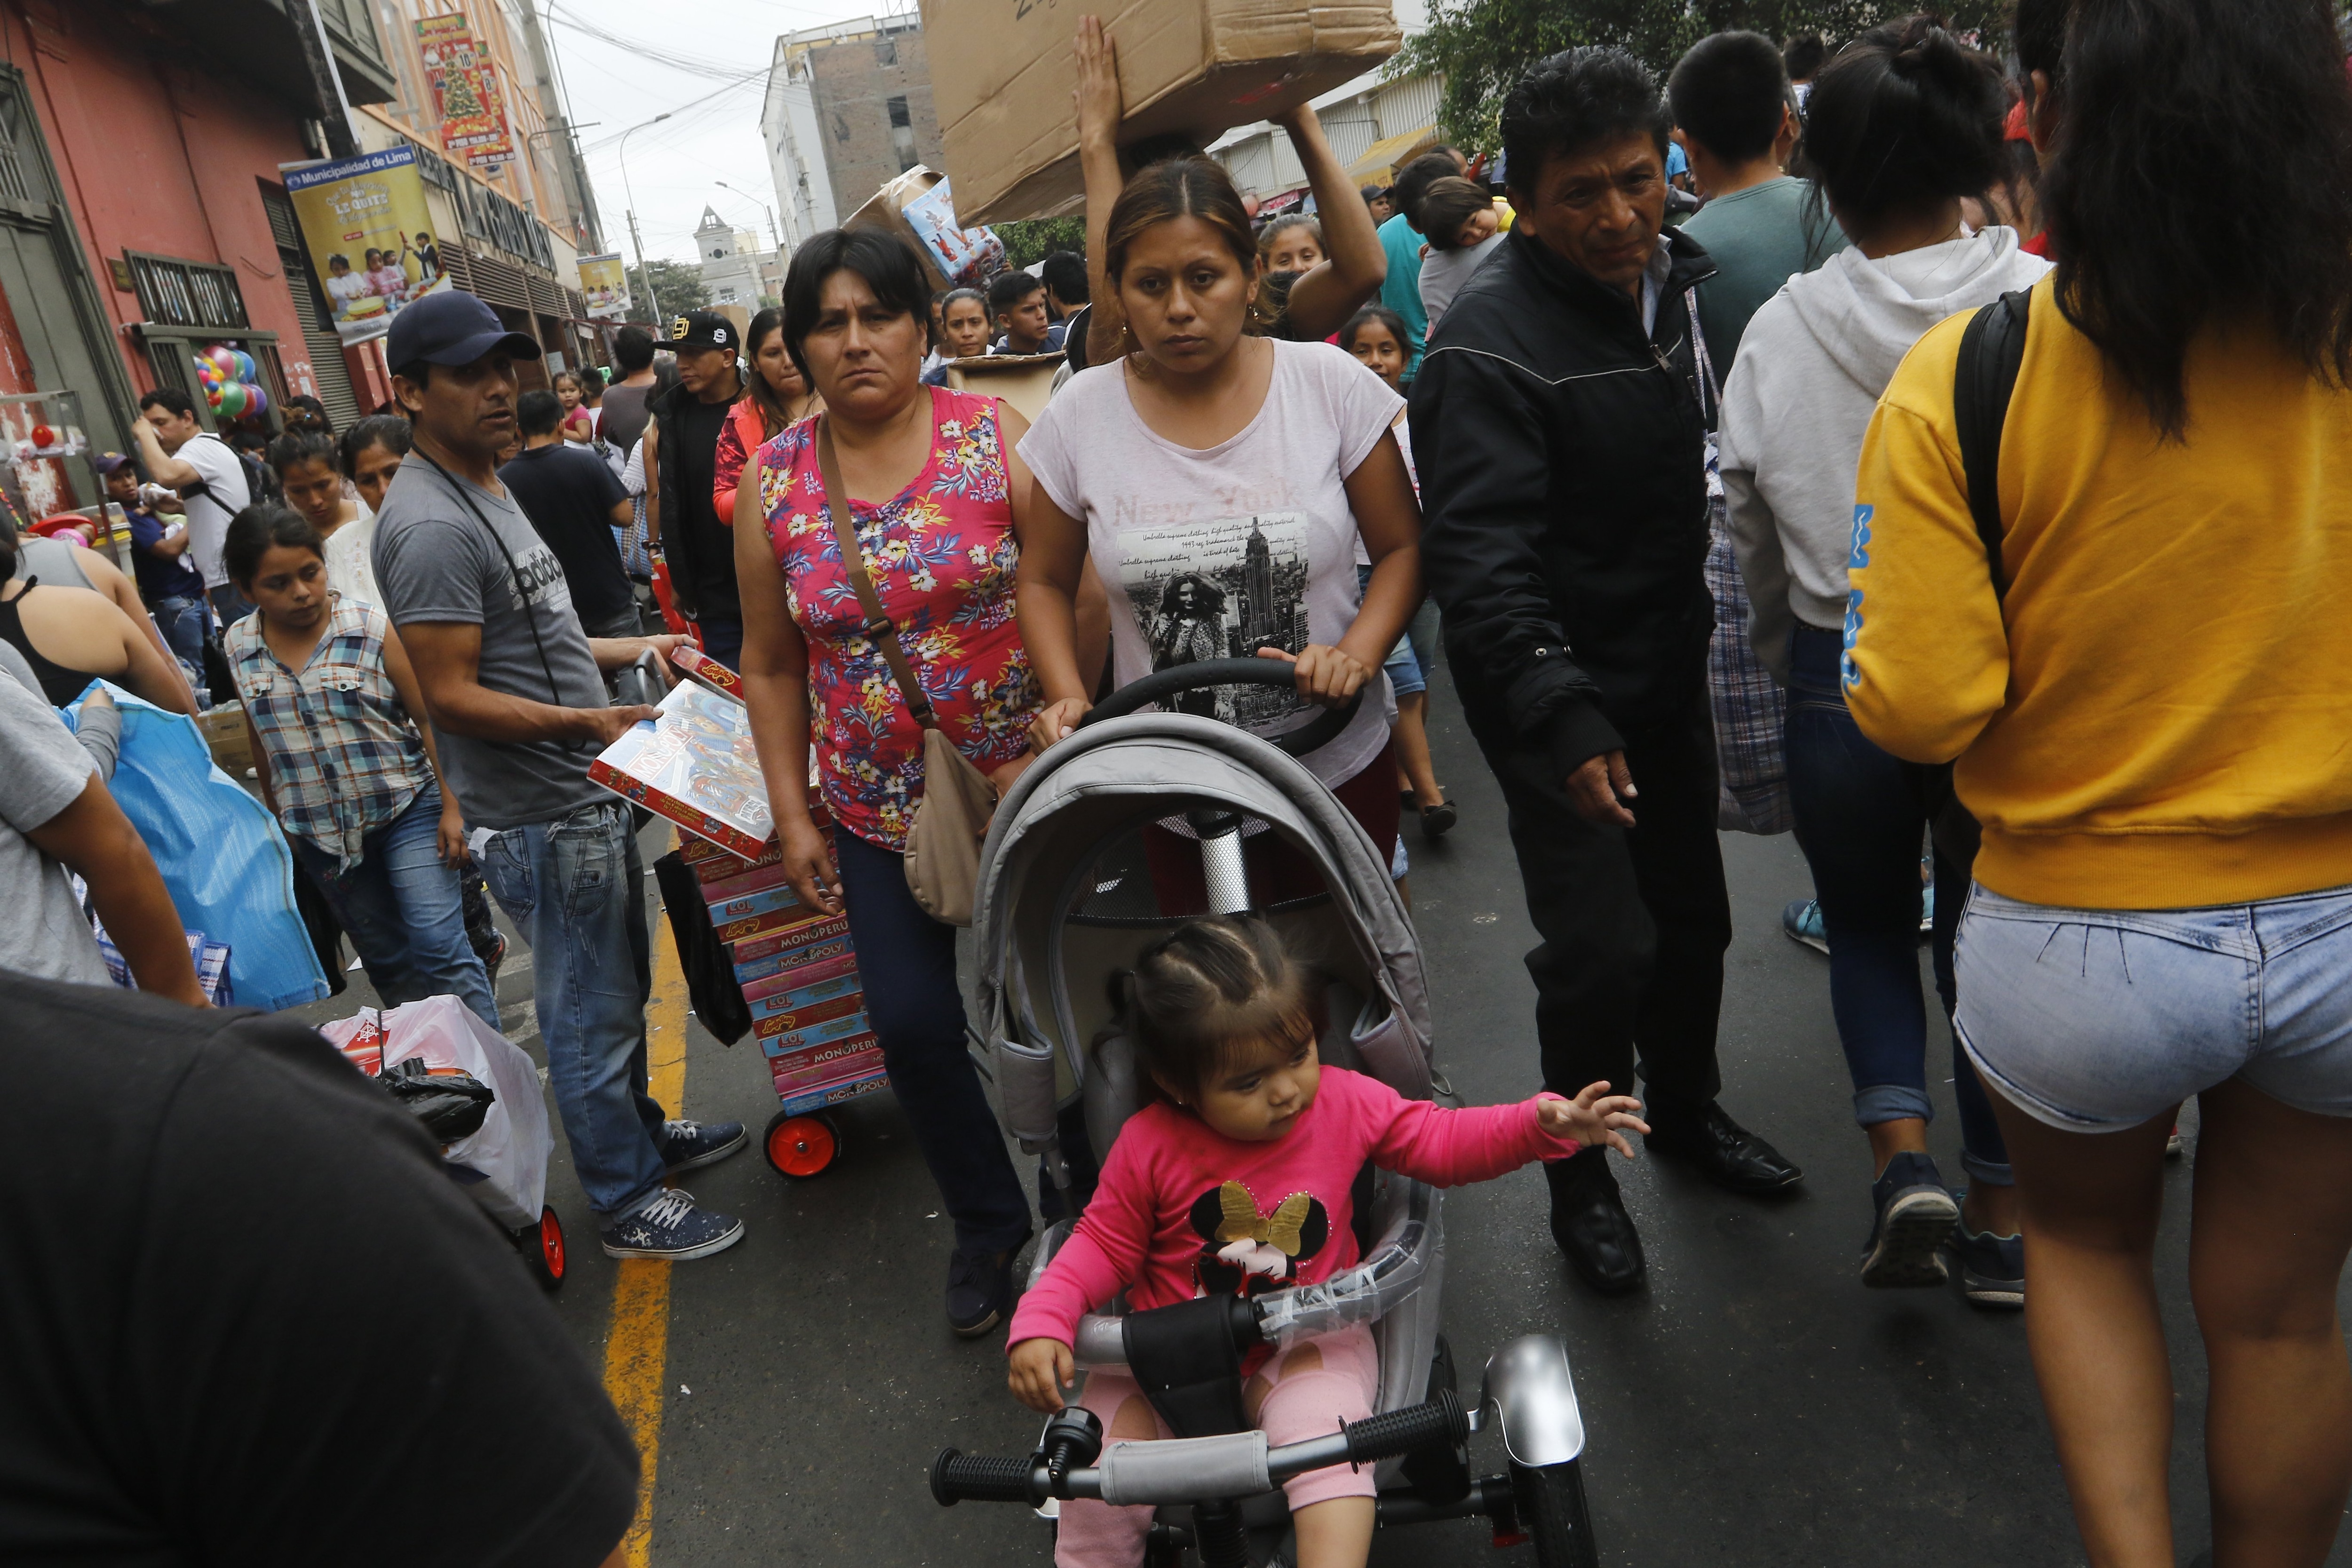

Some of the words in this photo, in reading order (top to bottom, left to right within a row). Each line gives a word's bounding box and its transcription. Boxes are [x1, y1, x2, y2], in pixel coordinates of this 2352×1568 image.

[301, 159, 371, 184] Municipalidad
[372, 157, 385, 167] de
[386, 151, 412, 164] Lima
[334, 203, 350, 215] LE
[351, 193, 388, 210] QUITE
[1188, 528, 1209, 537] clothing
[1223, 525, 1242, 534] quality
[1257, 520, 1273, 529] uality
[729, 899, 754, 912] LOL
[769, 995, 794, 1006] LOL
[781, 1032, 806, 1044] LOL
